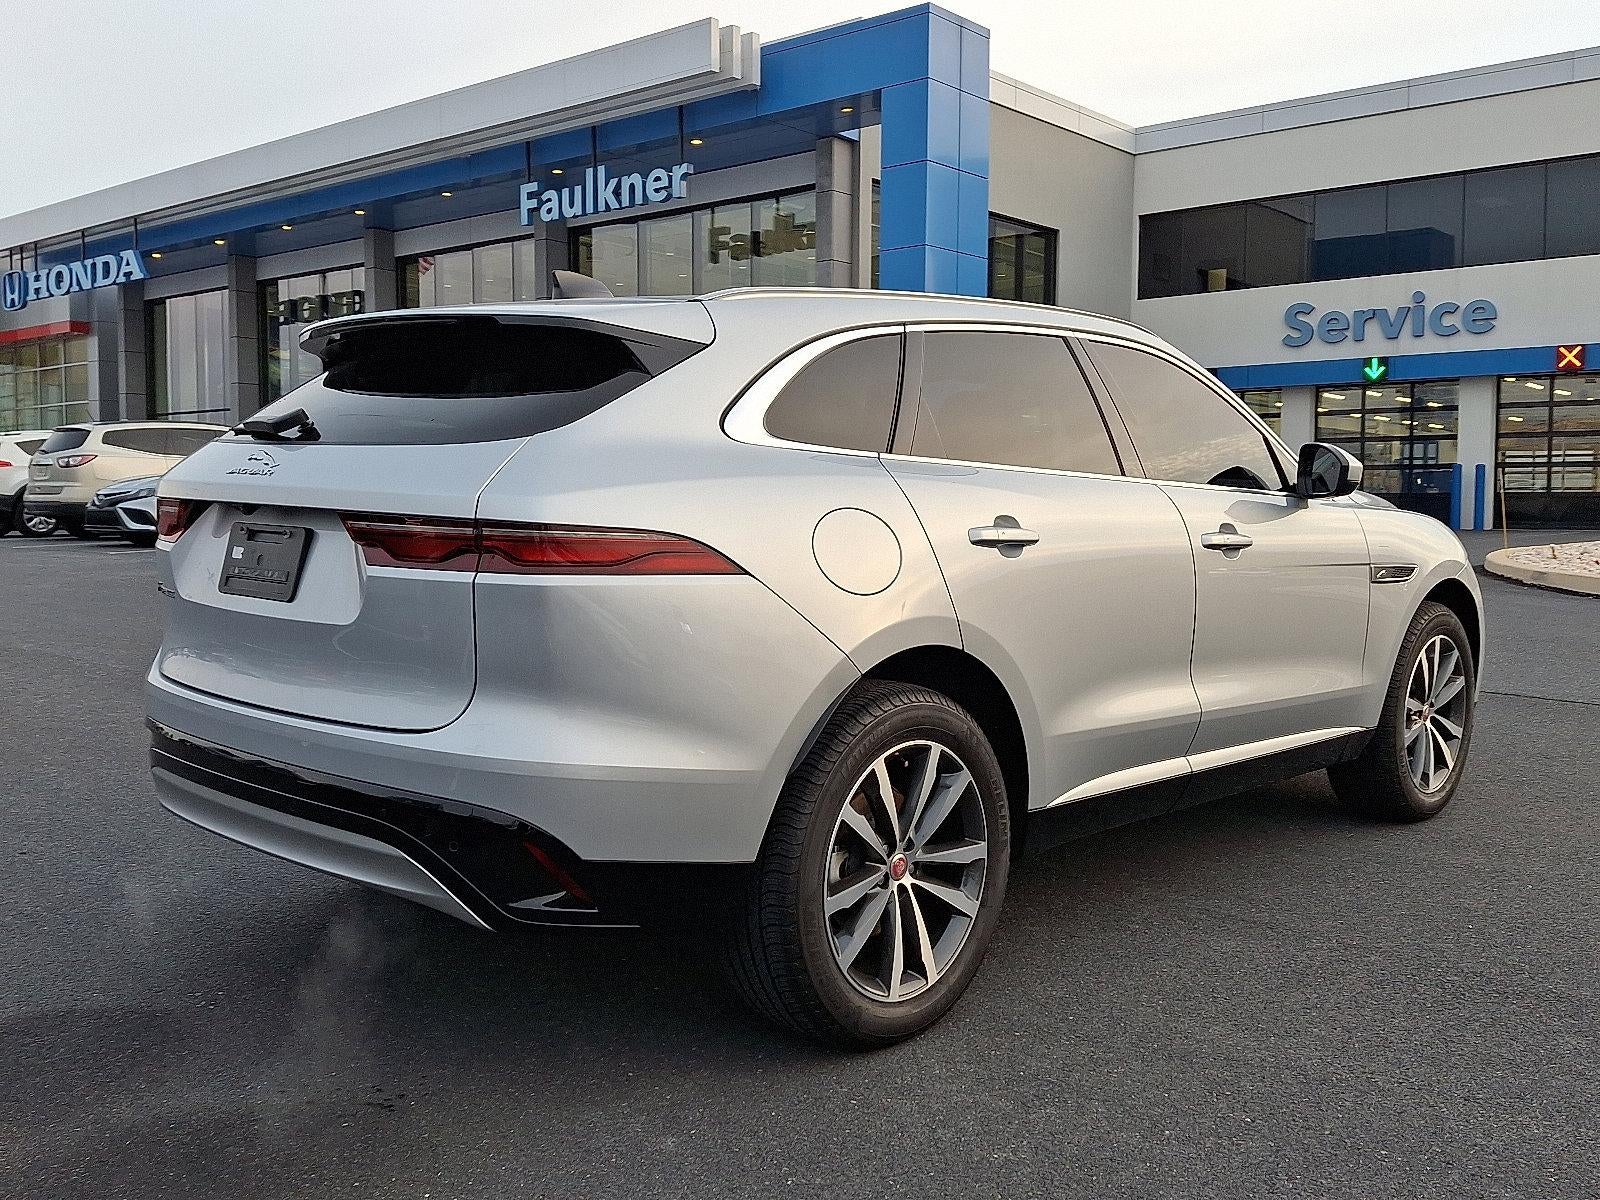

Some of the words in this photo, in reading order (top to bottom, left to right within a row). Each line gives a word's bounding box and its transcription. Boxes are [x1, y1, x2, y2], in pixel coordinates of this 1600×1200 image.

[519, 162, 693, 226] Faulkner
[27, 250, 145, 301] HONDA
[1282, 290, 1498, 347] Service
